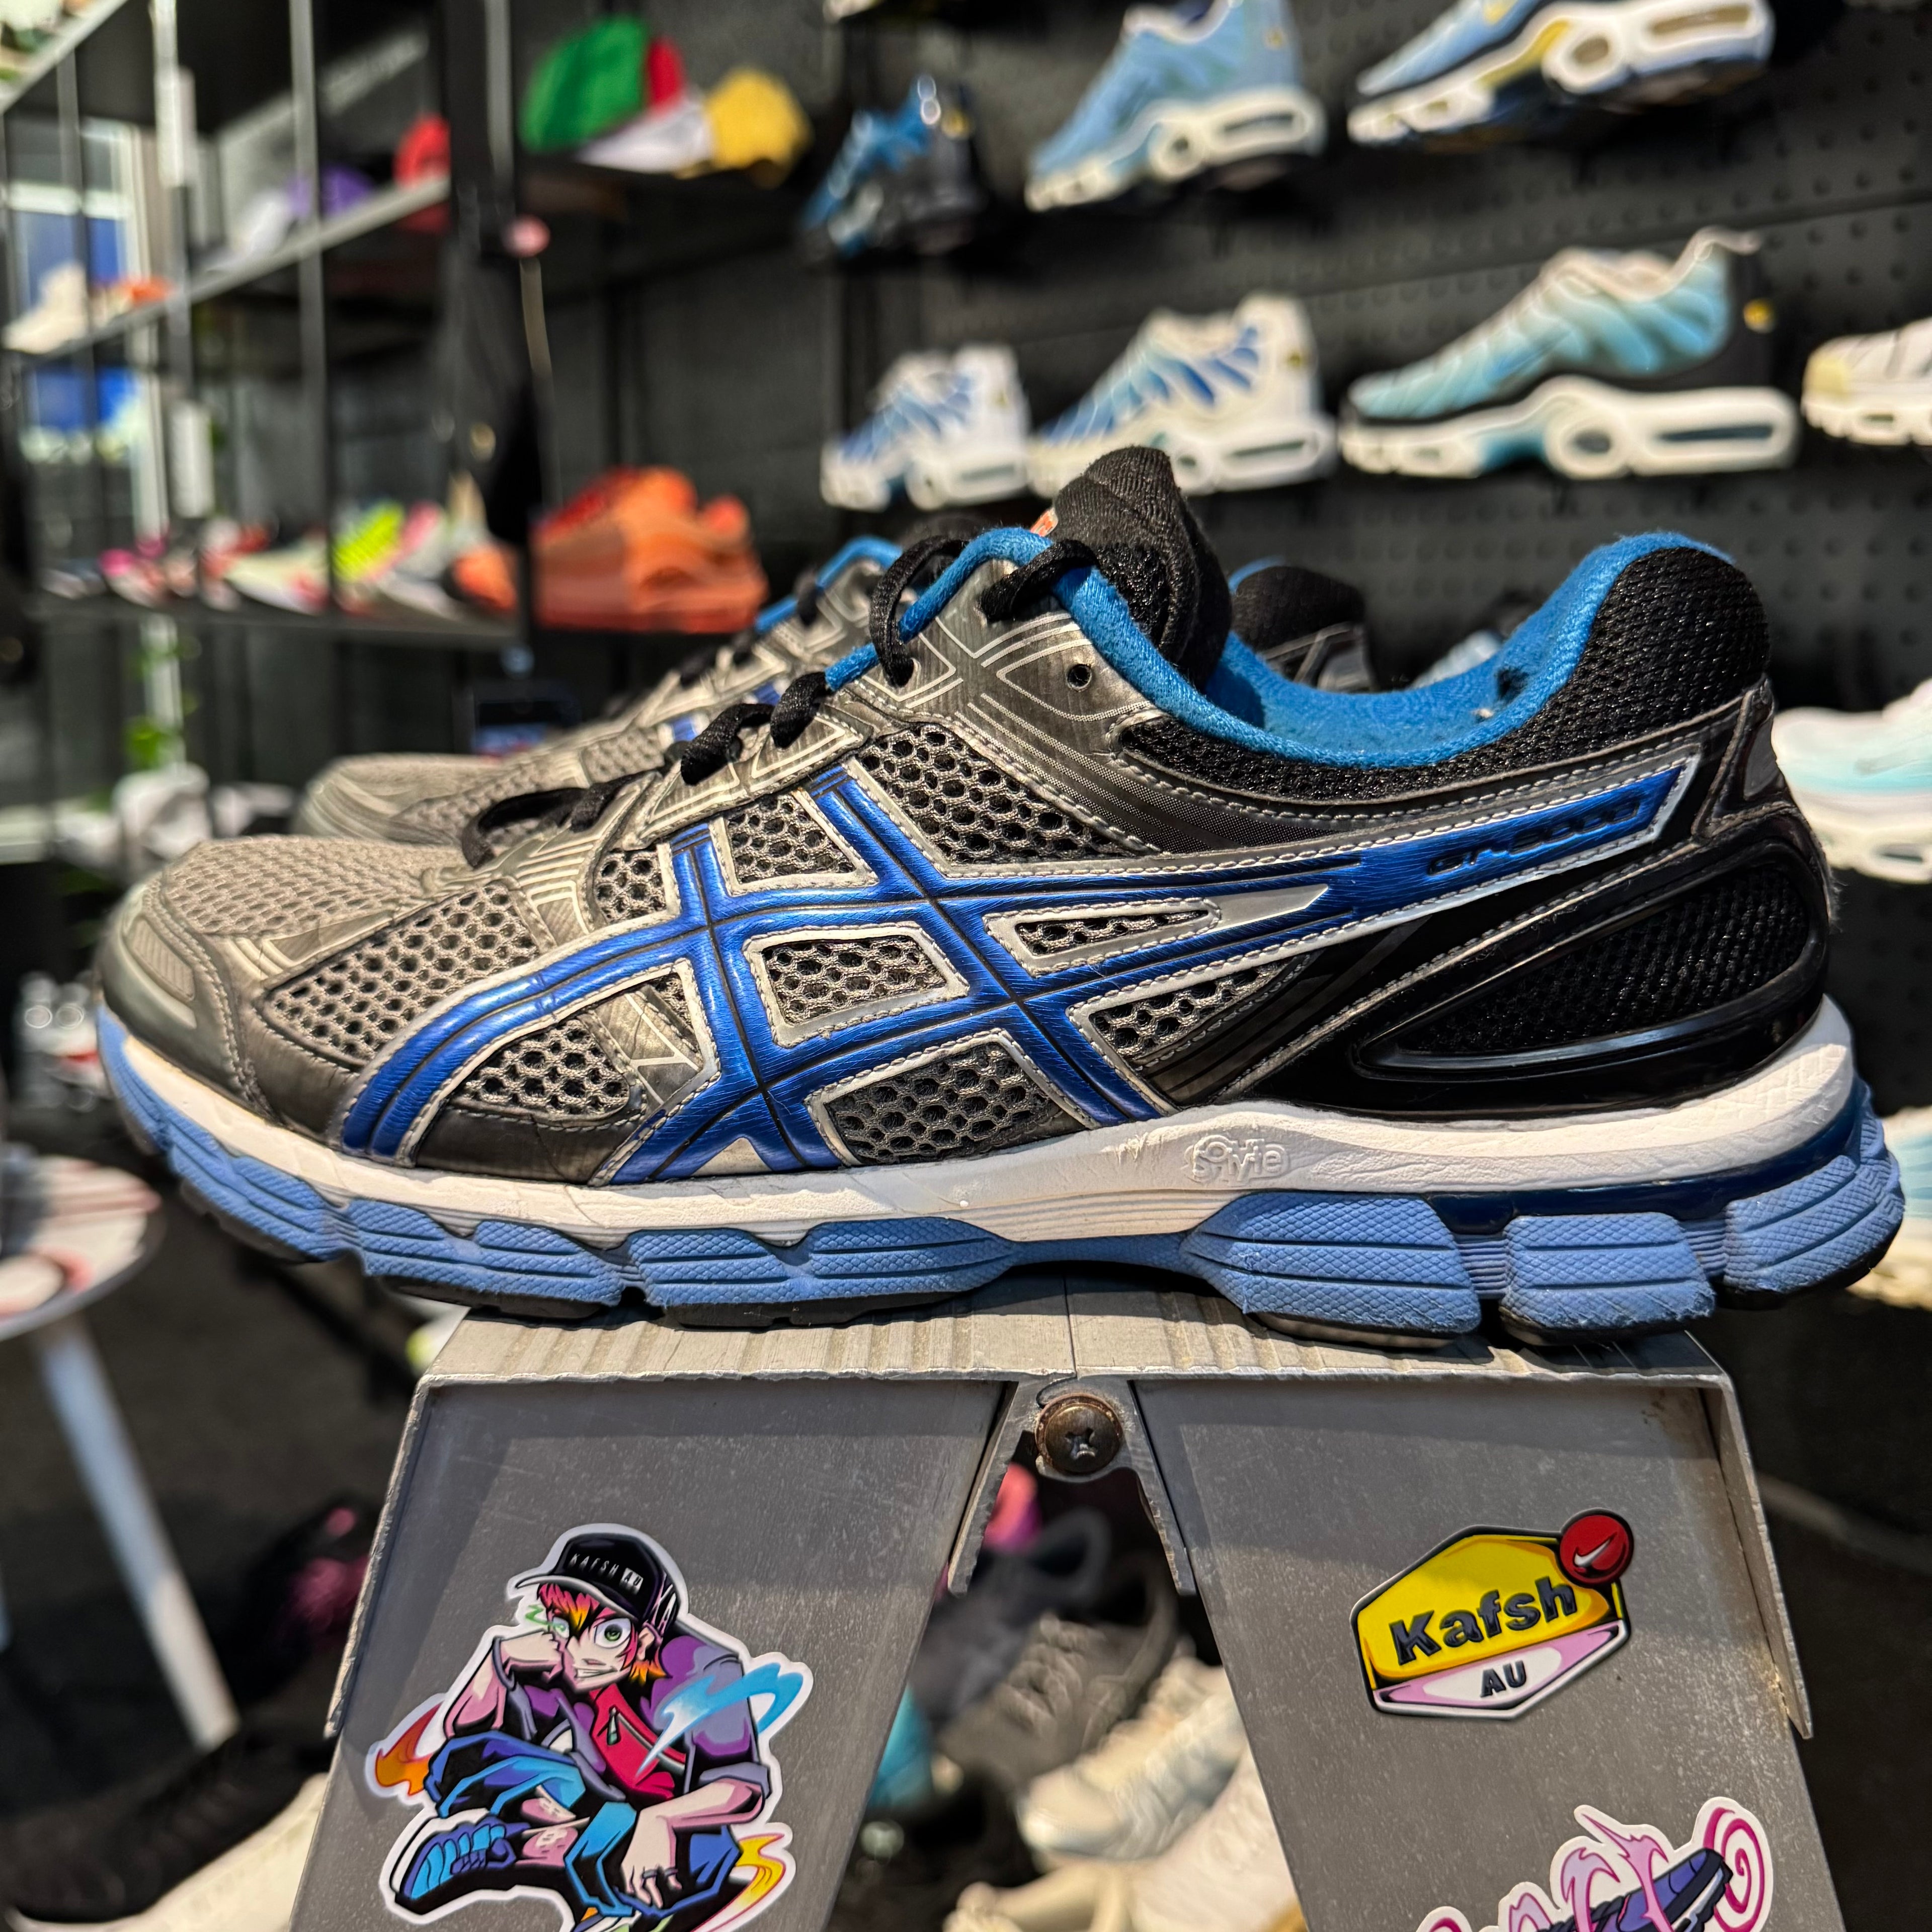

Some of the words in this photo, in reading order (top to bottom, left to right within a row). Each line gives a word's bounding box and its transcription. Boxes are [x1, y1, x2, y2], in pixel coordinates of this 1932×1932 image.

[622, 1571, 642, 1588] AU
[1389, 1576, 1578, 1666] Kafsh
[1480, 1660, 1527, 1698] AU
